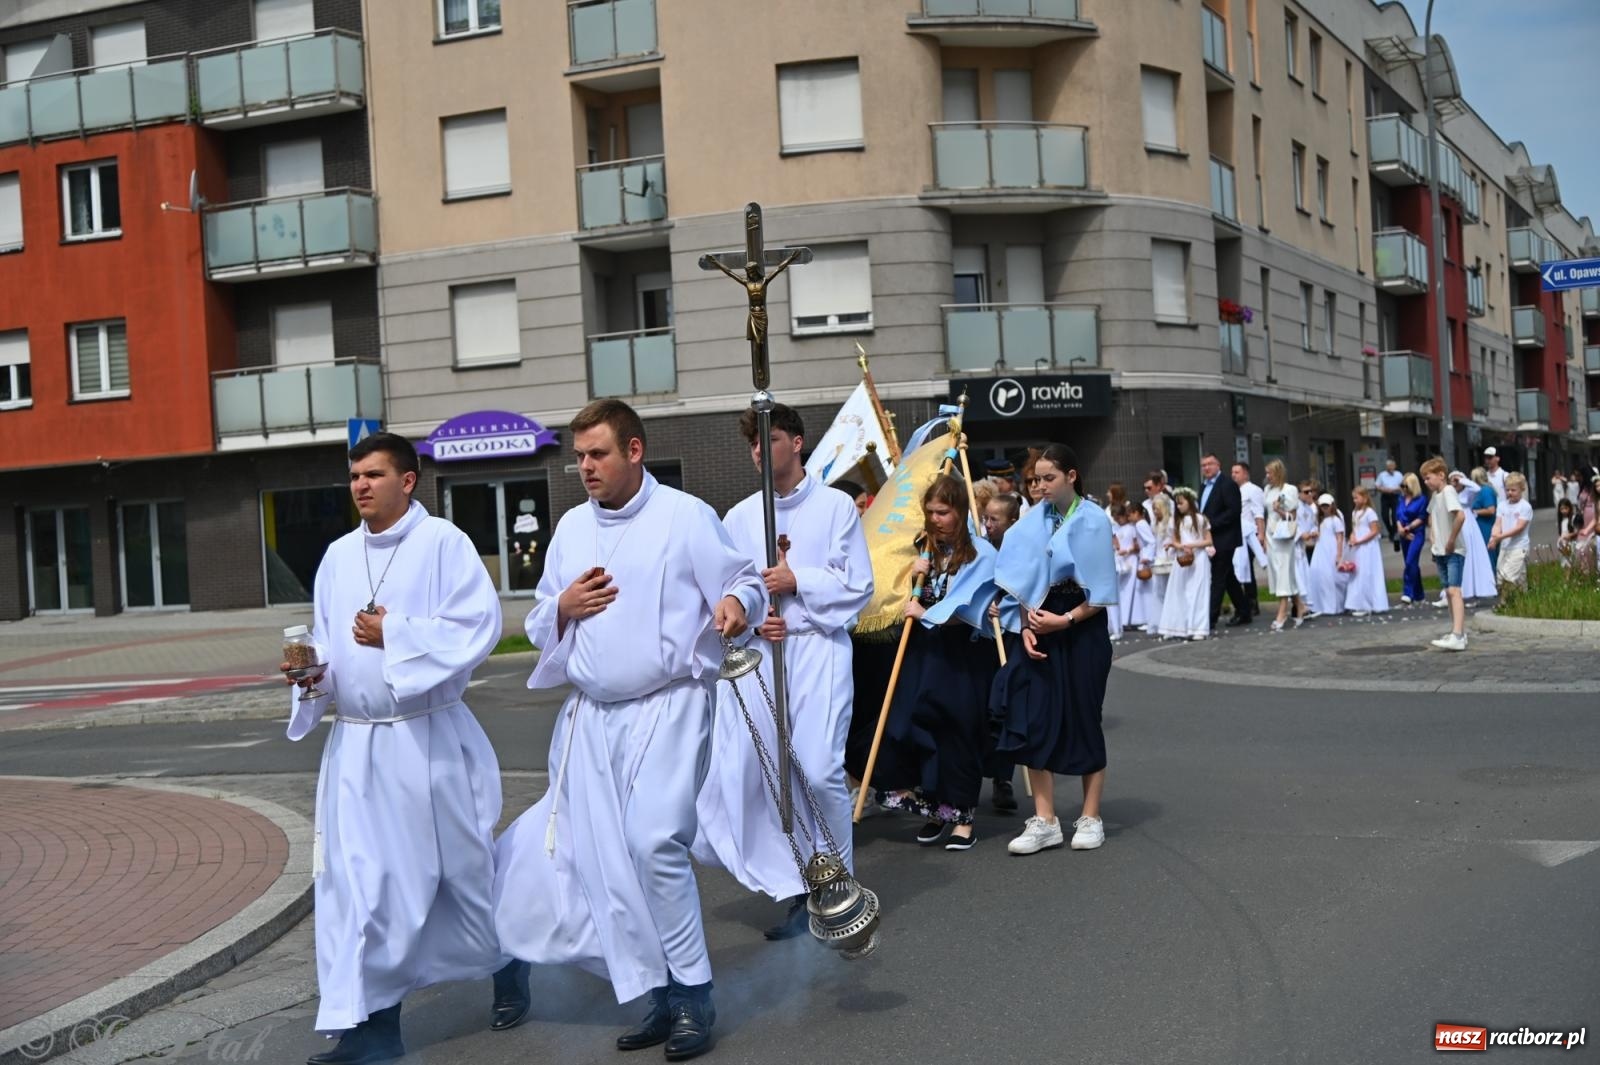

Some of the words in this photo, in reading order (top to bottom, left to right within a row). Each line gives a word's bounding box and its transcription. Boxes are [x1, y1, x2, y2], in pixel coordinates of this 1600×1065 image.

[1554, 269, 1567, 281] ul.
[1032, 381, 1083, 400] ravita
[437, 422, 530, 436] CUKIERNIA
[438, 438, 532, 457] JAGÓDKA
